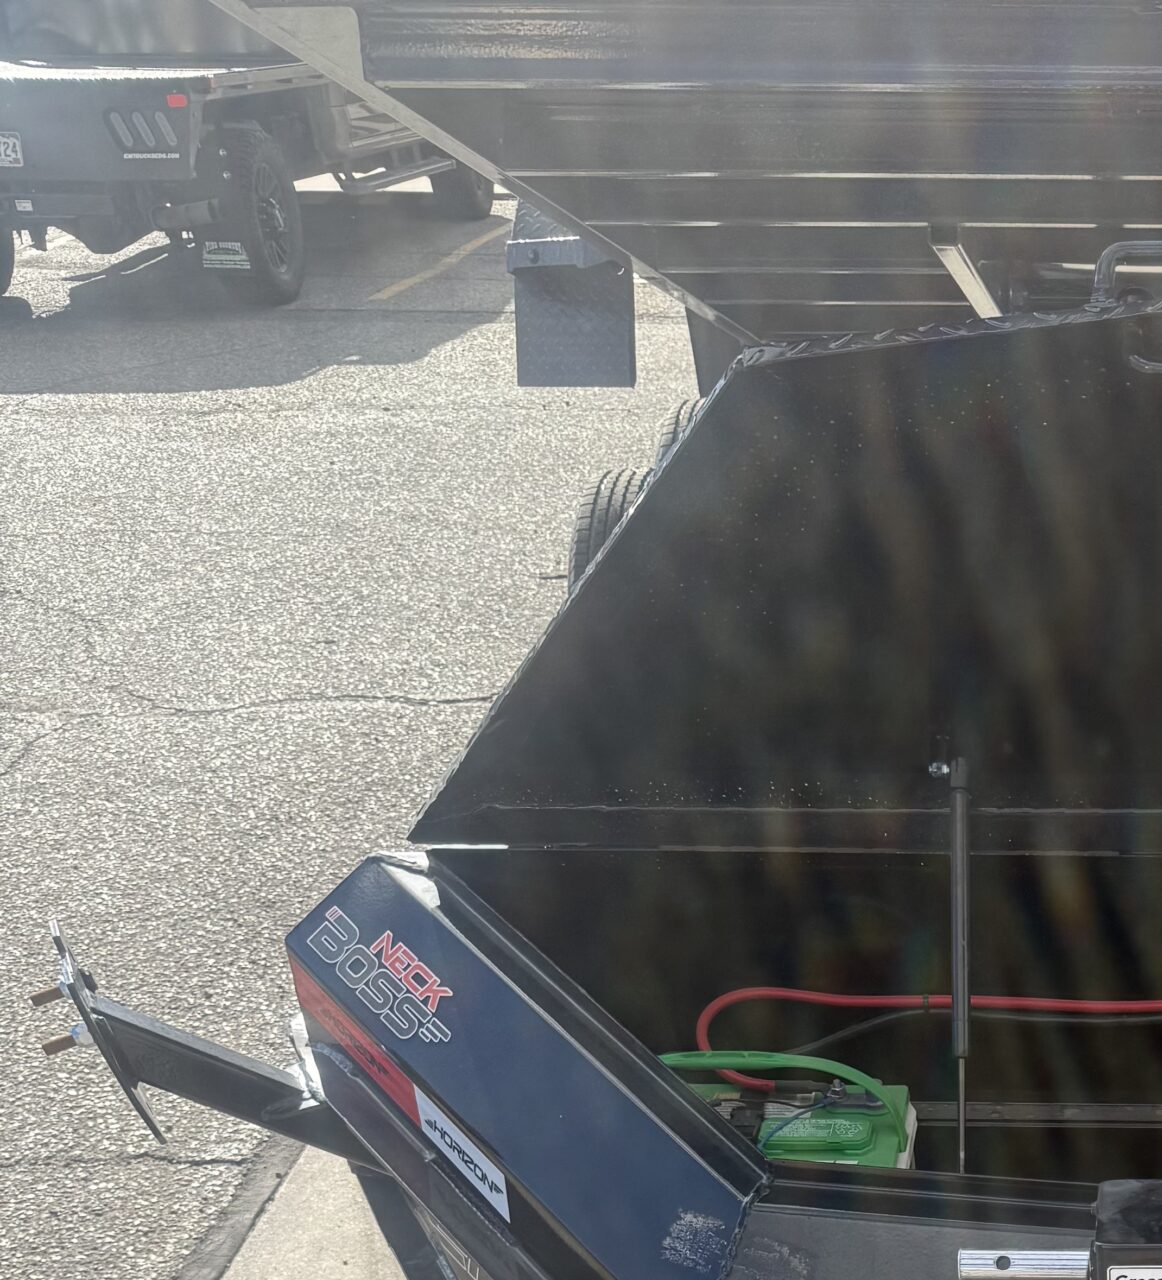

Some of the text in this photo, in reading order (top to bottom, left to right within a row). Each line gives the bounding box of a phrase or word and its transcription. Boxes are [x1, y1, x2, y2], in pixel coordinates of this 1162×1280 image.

[0, 140, 19, 158] 24
[306, 905, 434, 1040] BOSS
[369, 930, 453, 1013] NECK
[428, 1119, 502, 1194] HORIZON
